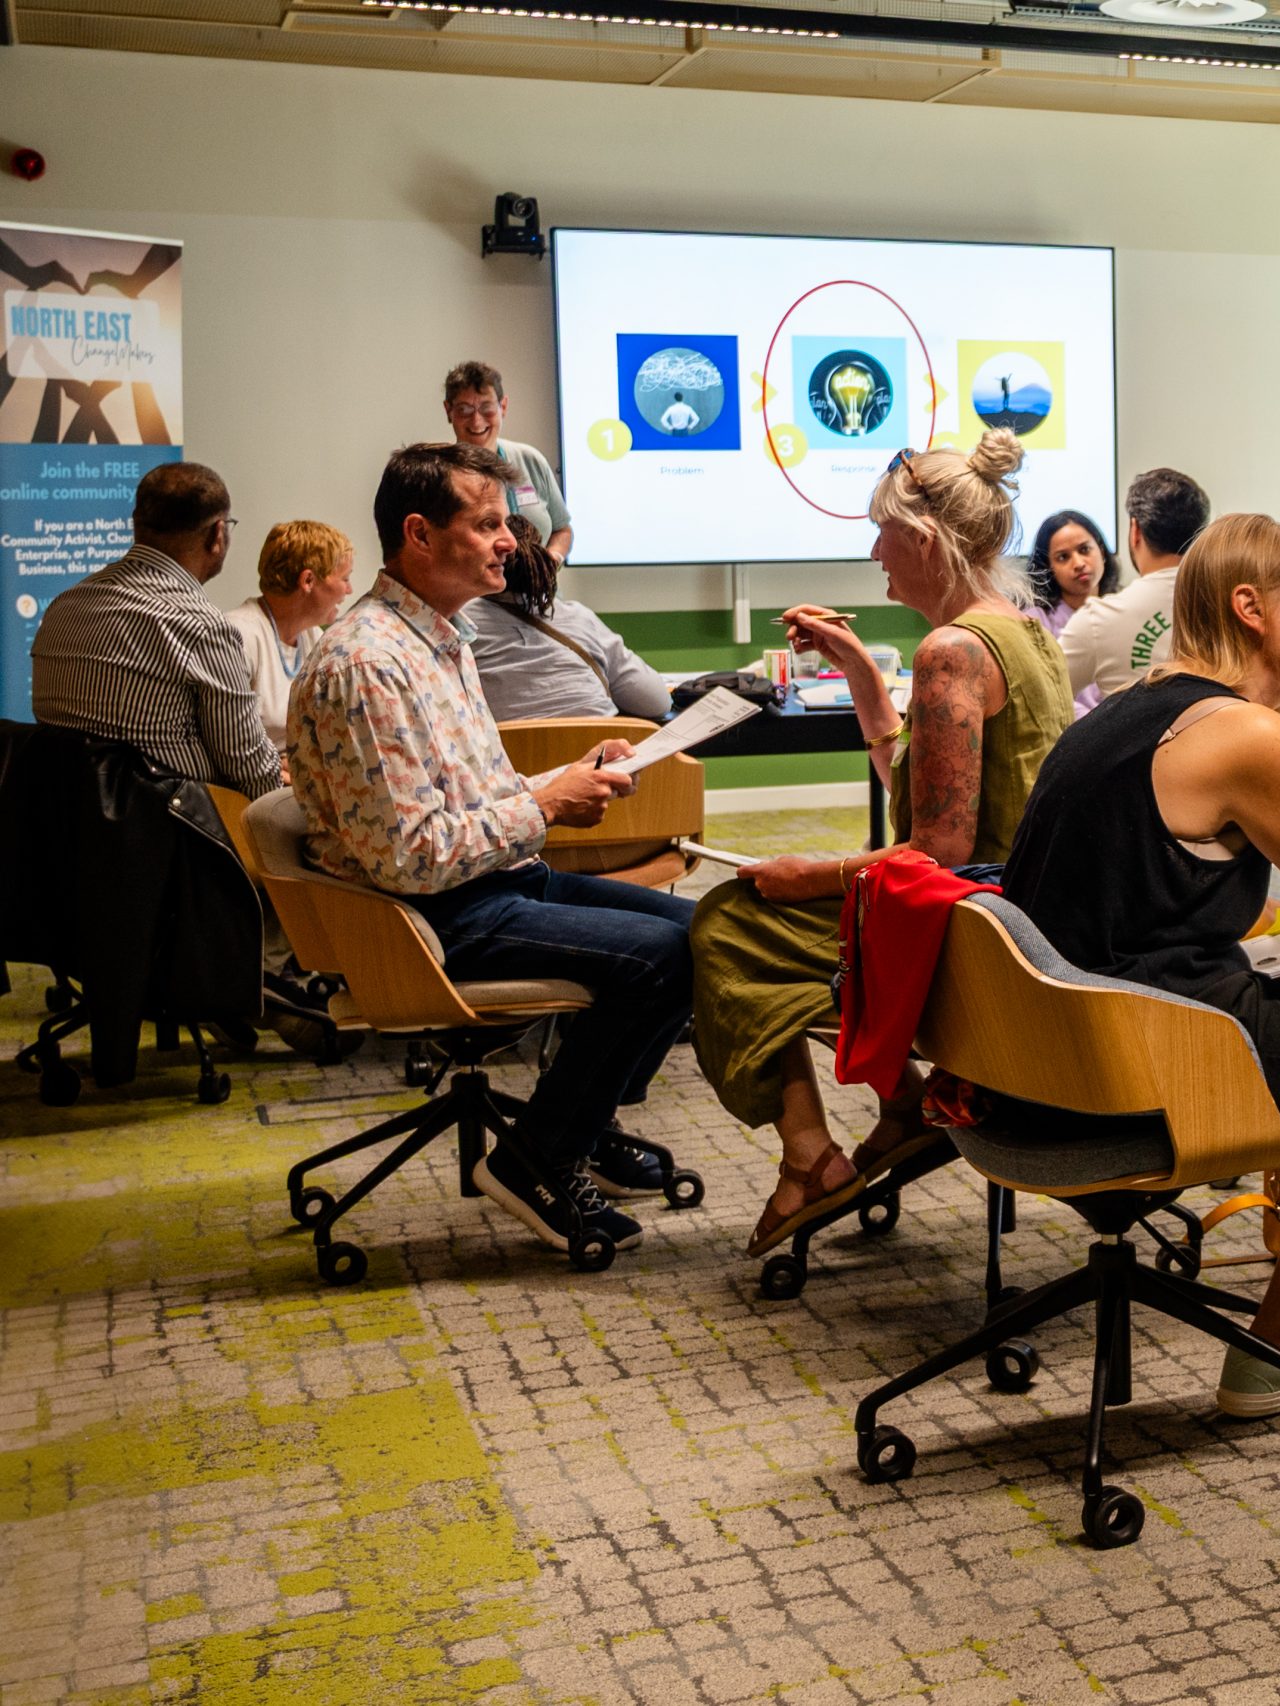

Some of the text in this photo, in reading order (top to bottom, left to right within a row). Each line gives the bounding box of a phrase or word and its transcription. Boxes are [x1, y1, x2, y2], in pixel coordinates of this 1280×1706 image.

[11, 305, 132, 342] NORTH EAST
[601, 428, 615, 453] 1
[778, 434, 795, 457] 3
[40, 461, 140, 479] Join the FREE
[660, 466, 705, 475] Problem
[0, 482, 136, 503] online community
[34, 519, 44, 532] If
[44, 521, 64, 535] you
[65, 522, 84, 531] are
[85, 522, 94, 531] a
[94, 518, 126, 531] North
[1, 533, 63, 548] Community
[64, 532, 106, 546] Activist,
[15, 547, 72, 563] Enterprise,
[73, 550, 86, 560] or
[18, 562, 66, 576] Business,
[67, 561, 87, 574] this
[1130, 611, 1172, 670] THREE
